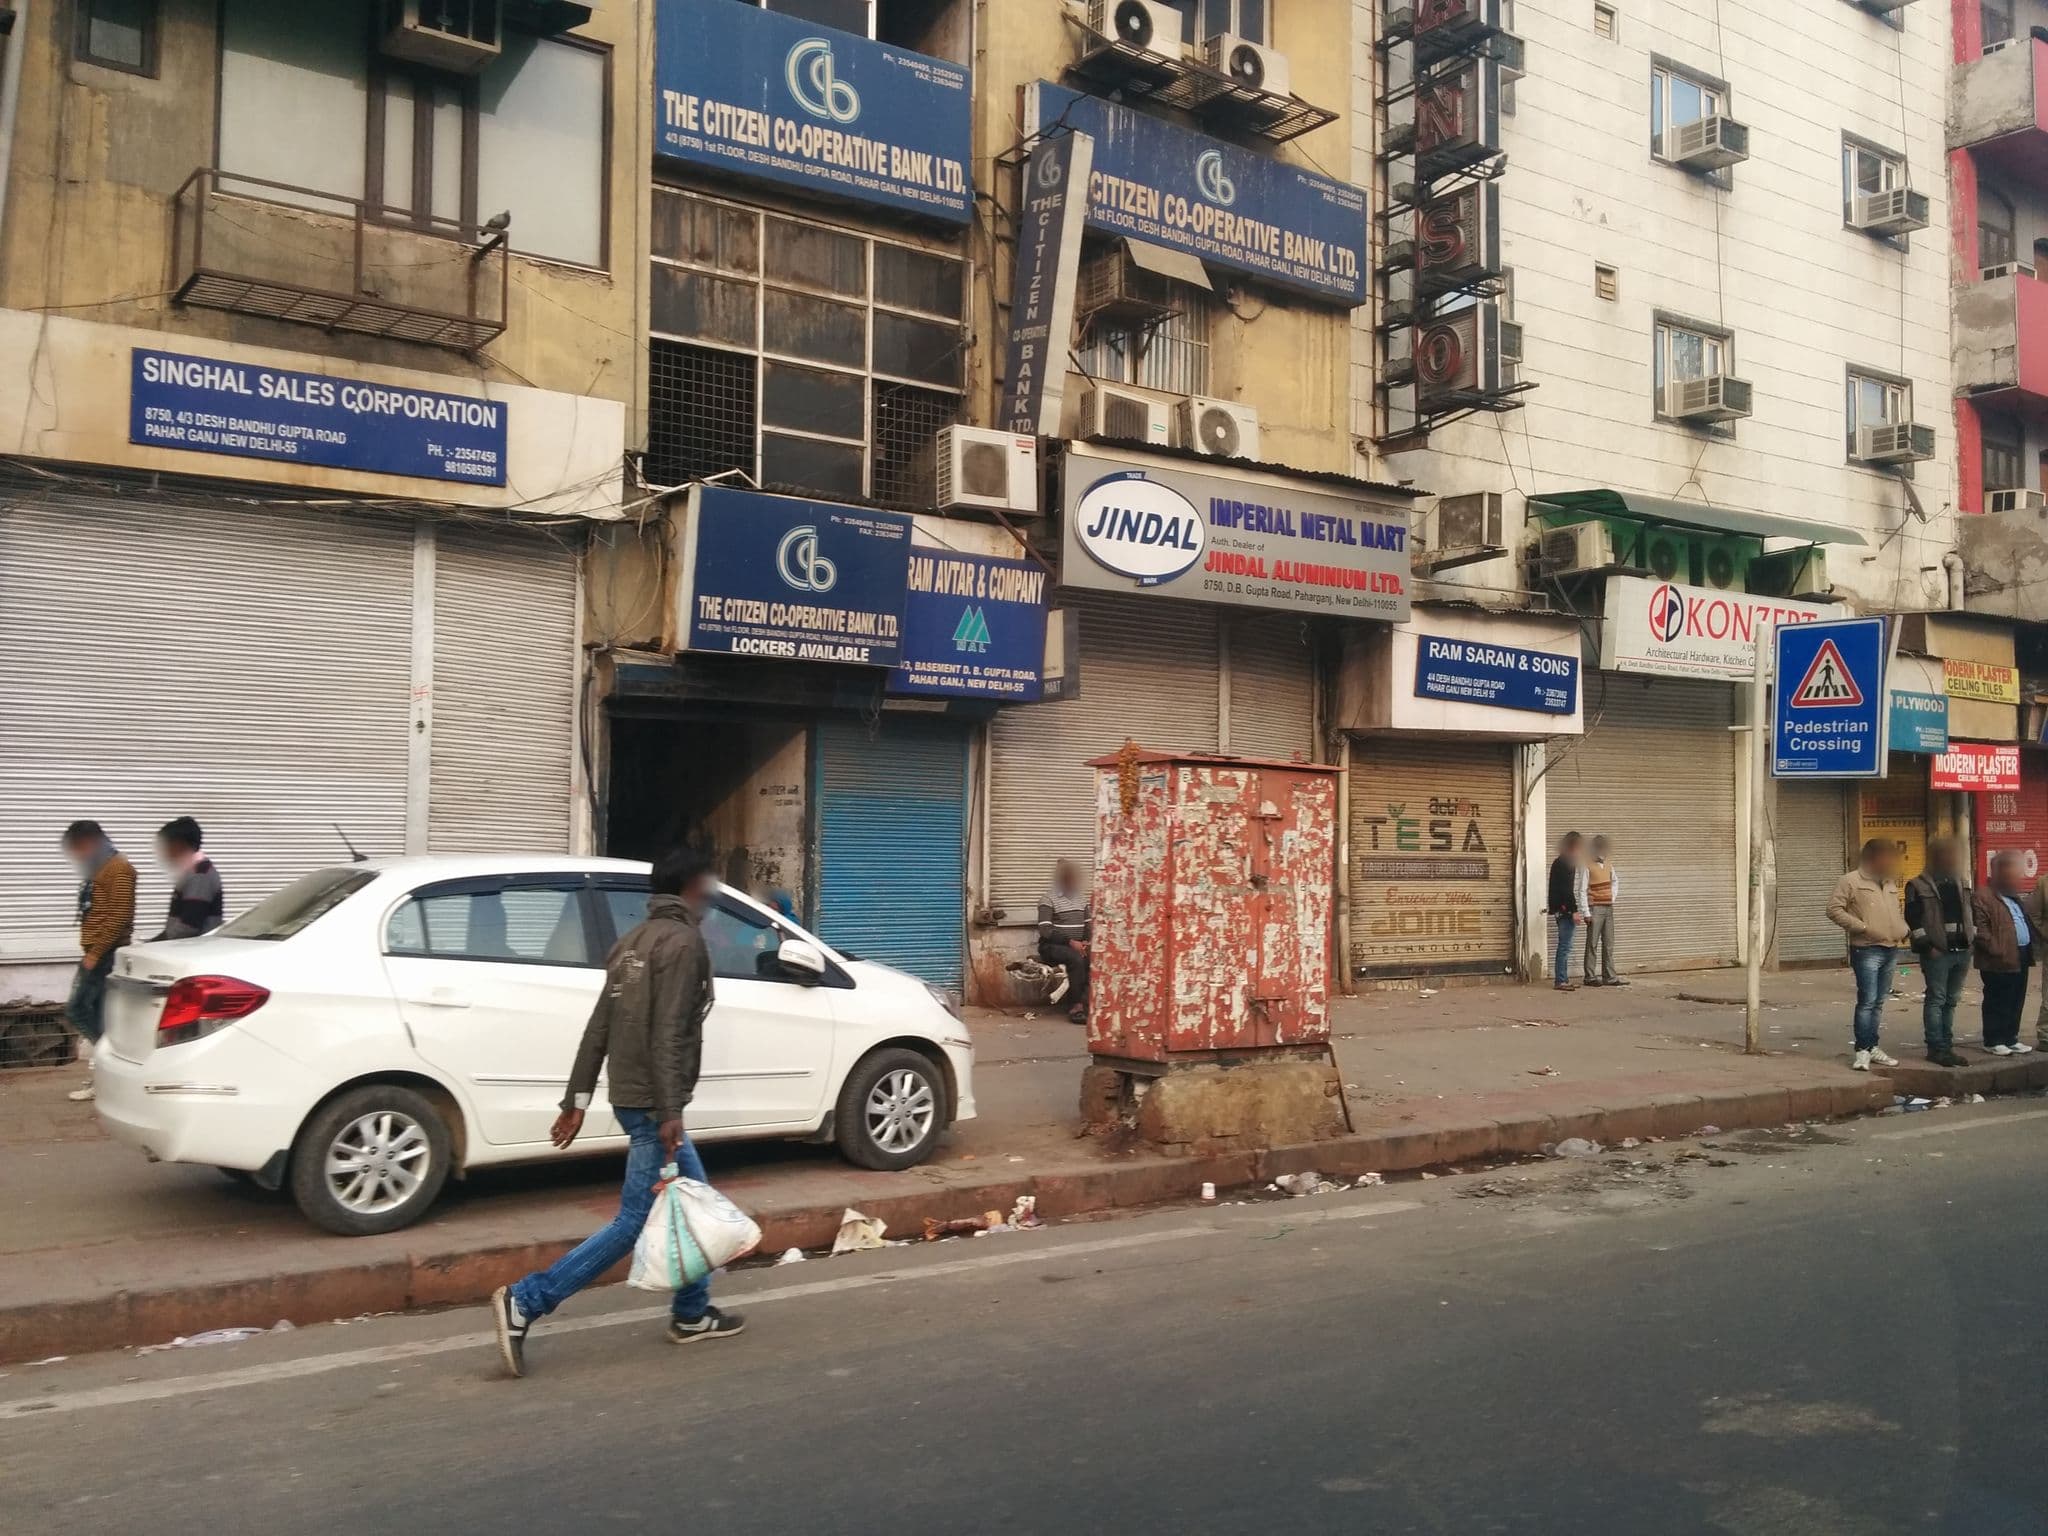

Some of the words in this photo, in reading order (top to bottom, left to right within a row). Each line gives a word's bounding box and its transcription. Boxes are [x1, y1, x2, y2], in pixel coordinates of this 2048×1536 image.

[915, 71, 931, 82] FAX:
[663, 90, 699, 131] THE
[703, 100, 769, 148] CITIZEN
[774, 117, 887, 175] CO-OPERATIVE
[891, 146, 932, 186] BANK
[936, 157, 966, 194] LTD.
[665, 132, 678, 144] 4/3
[704, 141, 716, 153] 1st
[717, 143, 747, 161] FLOOR,
[748, 151, 769, 164] DESH
[771, 156, 803, 172] BANDHU
[804, 164, 830, 178] GUPTA
[831, 171, 853, 185] ROAD,
[855, 176, 879, 190] PAHAR
[880, 181, 902, 197] GANJ,
[902, 187, 919, 199] NEW
[920, 190, 965, 210] DELHI-110055
[1031, 194, 1062, 212] THE
[1090, 170, 1159, 220] CITIZEN
[1164, 194, 1280, 256] CO-OPERATIVE
[1284, 230, 1325, 270] BANK
[1329, 244, 1359, 280] LTD.
[1093, 206, 1105, 219] 1st
[1106, 210, 1136, 231] FLOOR,
[1138, 219, 1160, 236] DESH
[1161, 226, 1193, 246] BANDHU
[1195, 236, 1220, 254] GUPTA
[1222, 244, 1244, 262] ROAD,
[1245, 251, 1270, 269] PAHAR
[1272, 259, 1292, 276] GANJ,
[1294, 265, 1310, 279] NEW
[1311, 268, 1355, 292] DELHI-110055
[1026, 213, 1049, 320] CITIZEN
[1014, 344, 1034, 413] BANK
[143, 357, 253, 394] SINGHAL
[258, 373, 335, 406] SALES
[341, 386, 497, 428] CORPORATION
[145, 407, 174, 424] 8750,
[177, 412, 193, 424] 4/3
[195, 414, 226, 428] DESH
[229, 418, 276, 436] BANDHU
[278, 424, 313, 440] GUPTA
[316, 429, 346, 444] ROAD
[1009, 419, 1034, 433] LTD.
[145, 424, 185, 440] PAHAR
[188, 430, 218, 445] GANJ
[221, 433, 248, 447] NEW
[250, 436, 297, 454] DELHI-55
[455, 447, 496, 463] 23547458
[1087, 506, 1198, 551] JINDAL
[1209, 497, 1296, 537] IMPERIAL
[1301, 511, 1357, 546] METAL
[1360, 521, 1406, 552] MART
[1211, 536, 1231, 547] Auth.
[1232, 539, 1256, 551] Dealer
[1257, 543, 1265, 551] of
[908, 556, 934, 592] RAM
[934, 560, 975, 597] AVTAR
[977, 564, 986, 598] &
[989, 566, 1045, 604] COMPANY
[1204, 550, 1268, 579] JINDAL
[1272, 560, 1367, 591] ALUMINIUM
[1371, 572, 1404, 595] LTD.
[1204, 579, 1225, 593] 8750,
[1227, 582, 1244, 594] D.B.
[1246, 584, 1269, 598] Gupta
[1271, 587, 1293, 599] Road,
[1295, 590, 1334, 606] Paharganj,
[1336, 595, 1351, 605] New
[1352, 596, 1397, 611] Delhi-110055
[699, 595, 722, 620] THE
[724, 598, 768, 624] CITIZEN
[770, 602, 846, 632] CO-OPERATIVE
[847, 611, 876, 635] BANK
[878, 614, 898, 637] LTD.
[732, 637, 796, 656] LOCKERS
[799, 643, 869, 662] AVAILABLE
[1429, 642, 1462, 660] RAM
[1466, 647, 1515, 669] SARAN
[1518, 655, 1528, 671] &
[1532, 657, 1570, 676] SONS
[1645, 647, 1688, 661] Architectural
[1689, 650, 1722, 664] Hardware,
[1723, 654, 1747, 666] Kitchen
[909, 674, 938, 685] PAHAR
[940, 676, 965, 688] GANJ,
[967, 679, 987, 689] NEW
[988, 680, 1024, 692] DELHI-55
[914, 662, 961, 674] BASEMENT
[963, 665, 971, 675] D.
[973, 666, 981, 676] B.
[984, 667, 1011, 678] GUPTA
[1013, 670, 1037, 681] ROAD,
[1436, 673, 1450, 683] DESH
[1451, 675, 1472, 686] BANDHU
[1473, 678, 1490, 688] GUPTA
[1491, 680, 1506, 690] ROAD
[1977, 664, 2013, 684] PLASTER
[1427, 682, 1445, 692] PAHAR
[1446, 684, 1459, 694] GANJ
[1460, 686, 1472, 696] NEW
[1472, 688, 1488, 698] DELHI
[1948, 678, 1980, 693] CEILING
[1982, 682, 2004, 696] TILES
[1896, 696, 1944, 712] PLYWOOD
[1784, 720, 1868, 733] Pedestrian
[1790, 737, 1861, 753] Crossing
[1935, 753, 1975, 774] MODERN
[1977, 754, 2018, 775] PLASTER
[1958, 774, 1979, 782] CEILING
[1983, 775, 1997, 783] TILES
[1363, 818, 1488, 851] TESA
[1369, 943, 1482, 954] TECHNOLOGY
